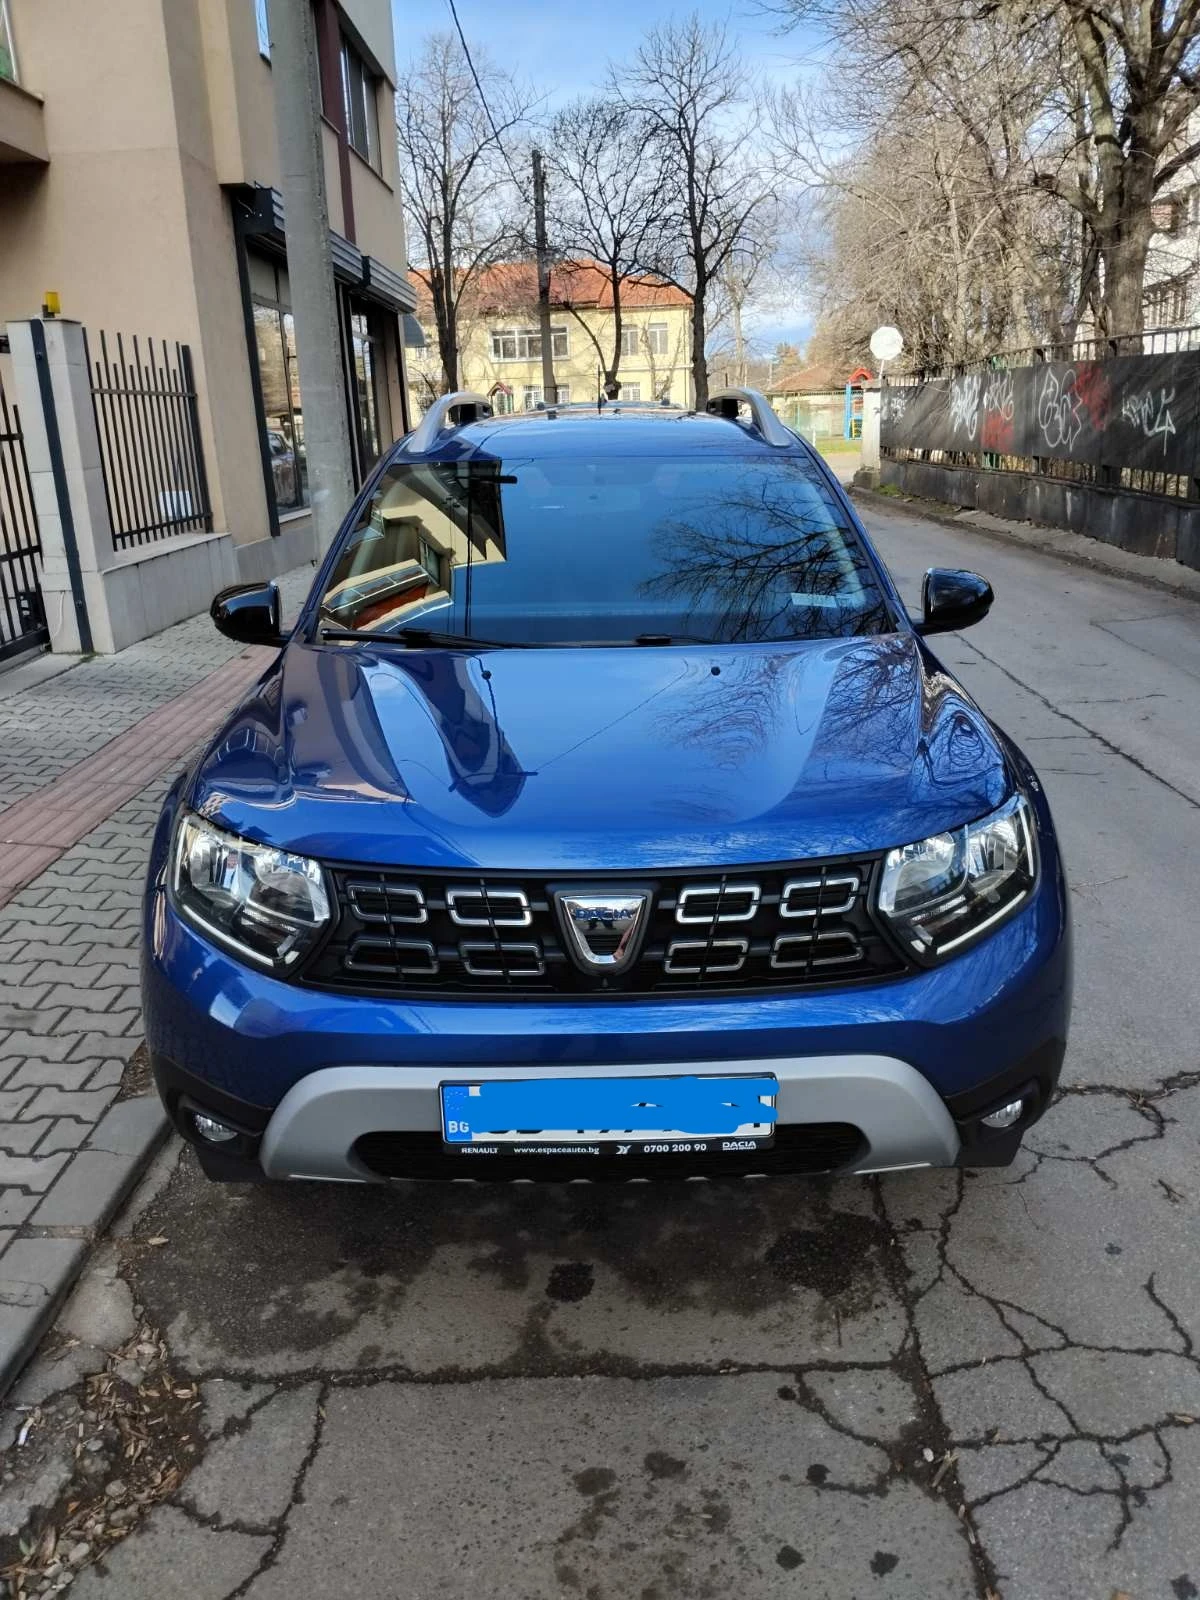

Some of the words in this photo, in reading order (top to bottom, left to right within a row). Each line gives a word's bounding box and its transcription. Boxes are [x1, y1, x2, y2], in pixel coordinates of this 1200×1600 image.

[576, 908, 632, 920] DACIA
[448, 1120, 470, 1134] BG
[643, 1144, 670, 1153] 0700
[672, 1143, 692, 1152] 200
[694, 1143, 707, 1151] 90
[722, 1141, 757, 1149] DACIA
[513, 1146, 600, 1155] www.espaceauto.bg
